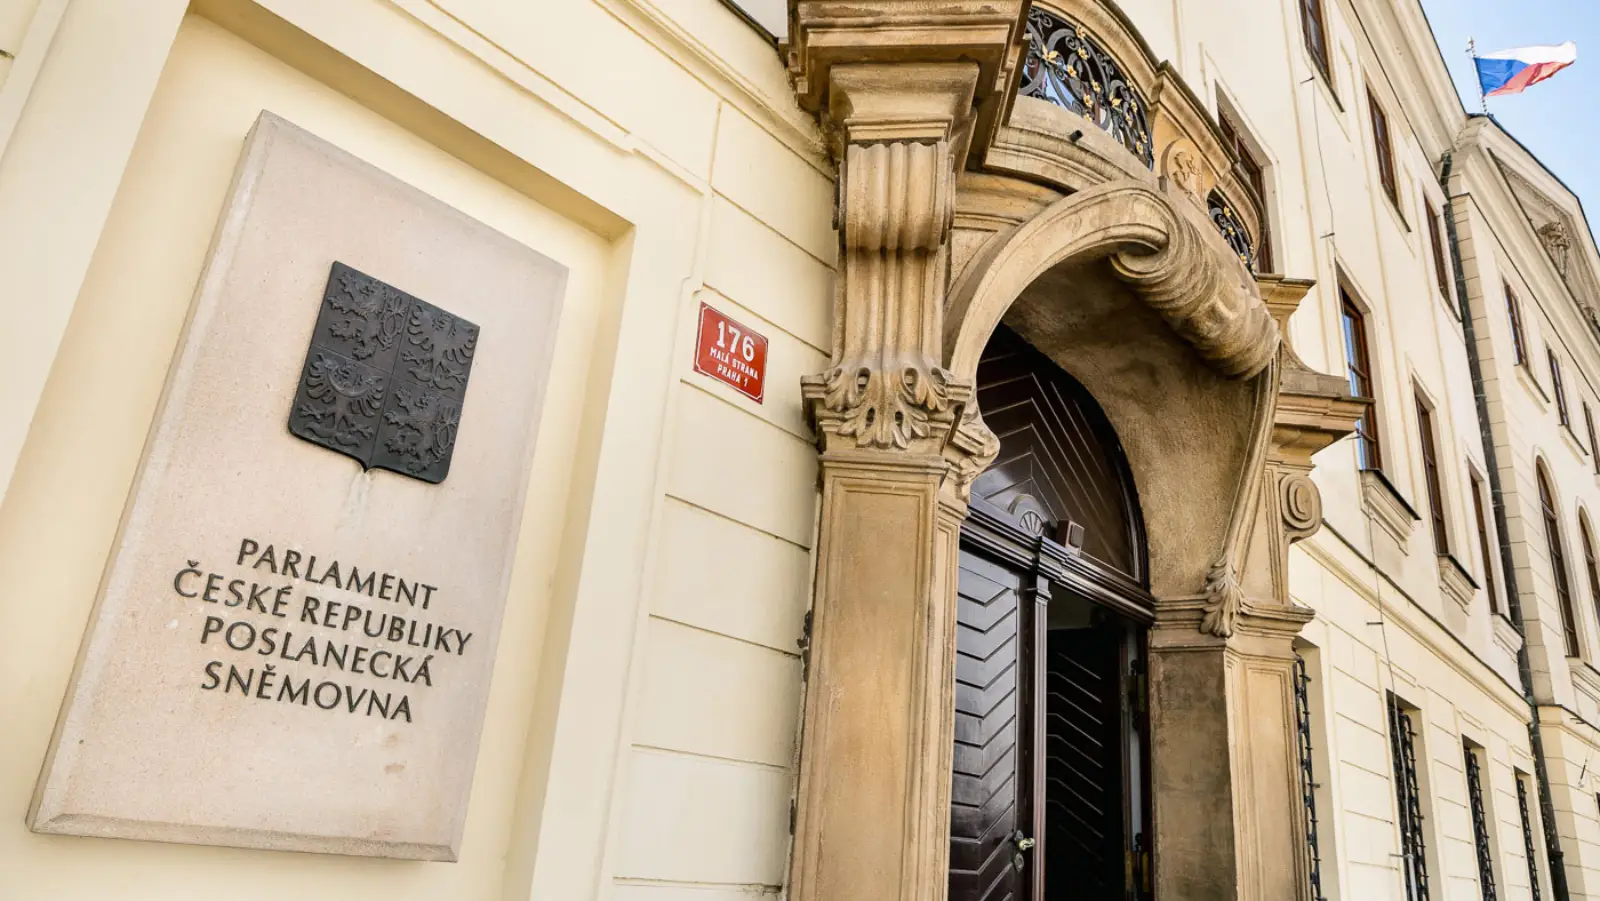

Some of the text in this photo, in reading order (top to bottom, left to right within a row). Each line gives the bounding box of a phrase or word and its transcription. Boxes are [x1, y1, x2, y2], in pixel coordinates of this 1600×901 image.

[709, 347, 759, 380] MALÁ STRANA
[716, 320, 755, 362] 176
[717, 363, 748, 387] PRAHA 1
[236, 538, 438, 610] PARLAMENT
[173, 559, 473, 656] ČESKÉ REPUBLIKY
[200, 615, 434, 686] POSLANECKÁ
[201, 660, 413, 723] SNĚMOVNA
